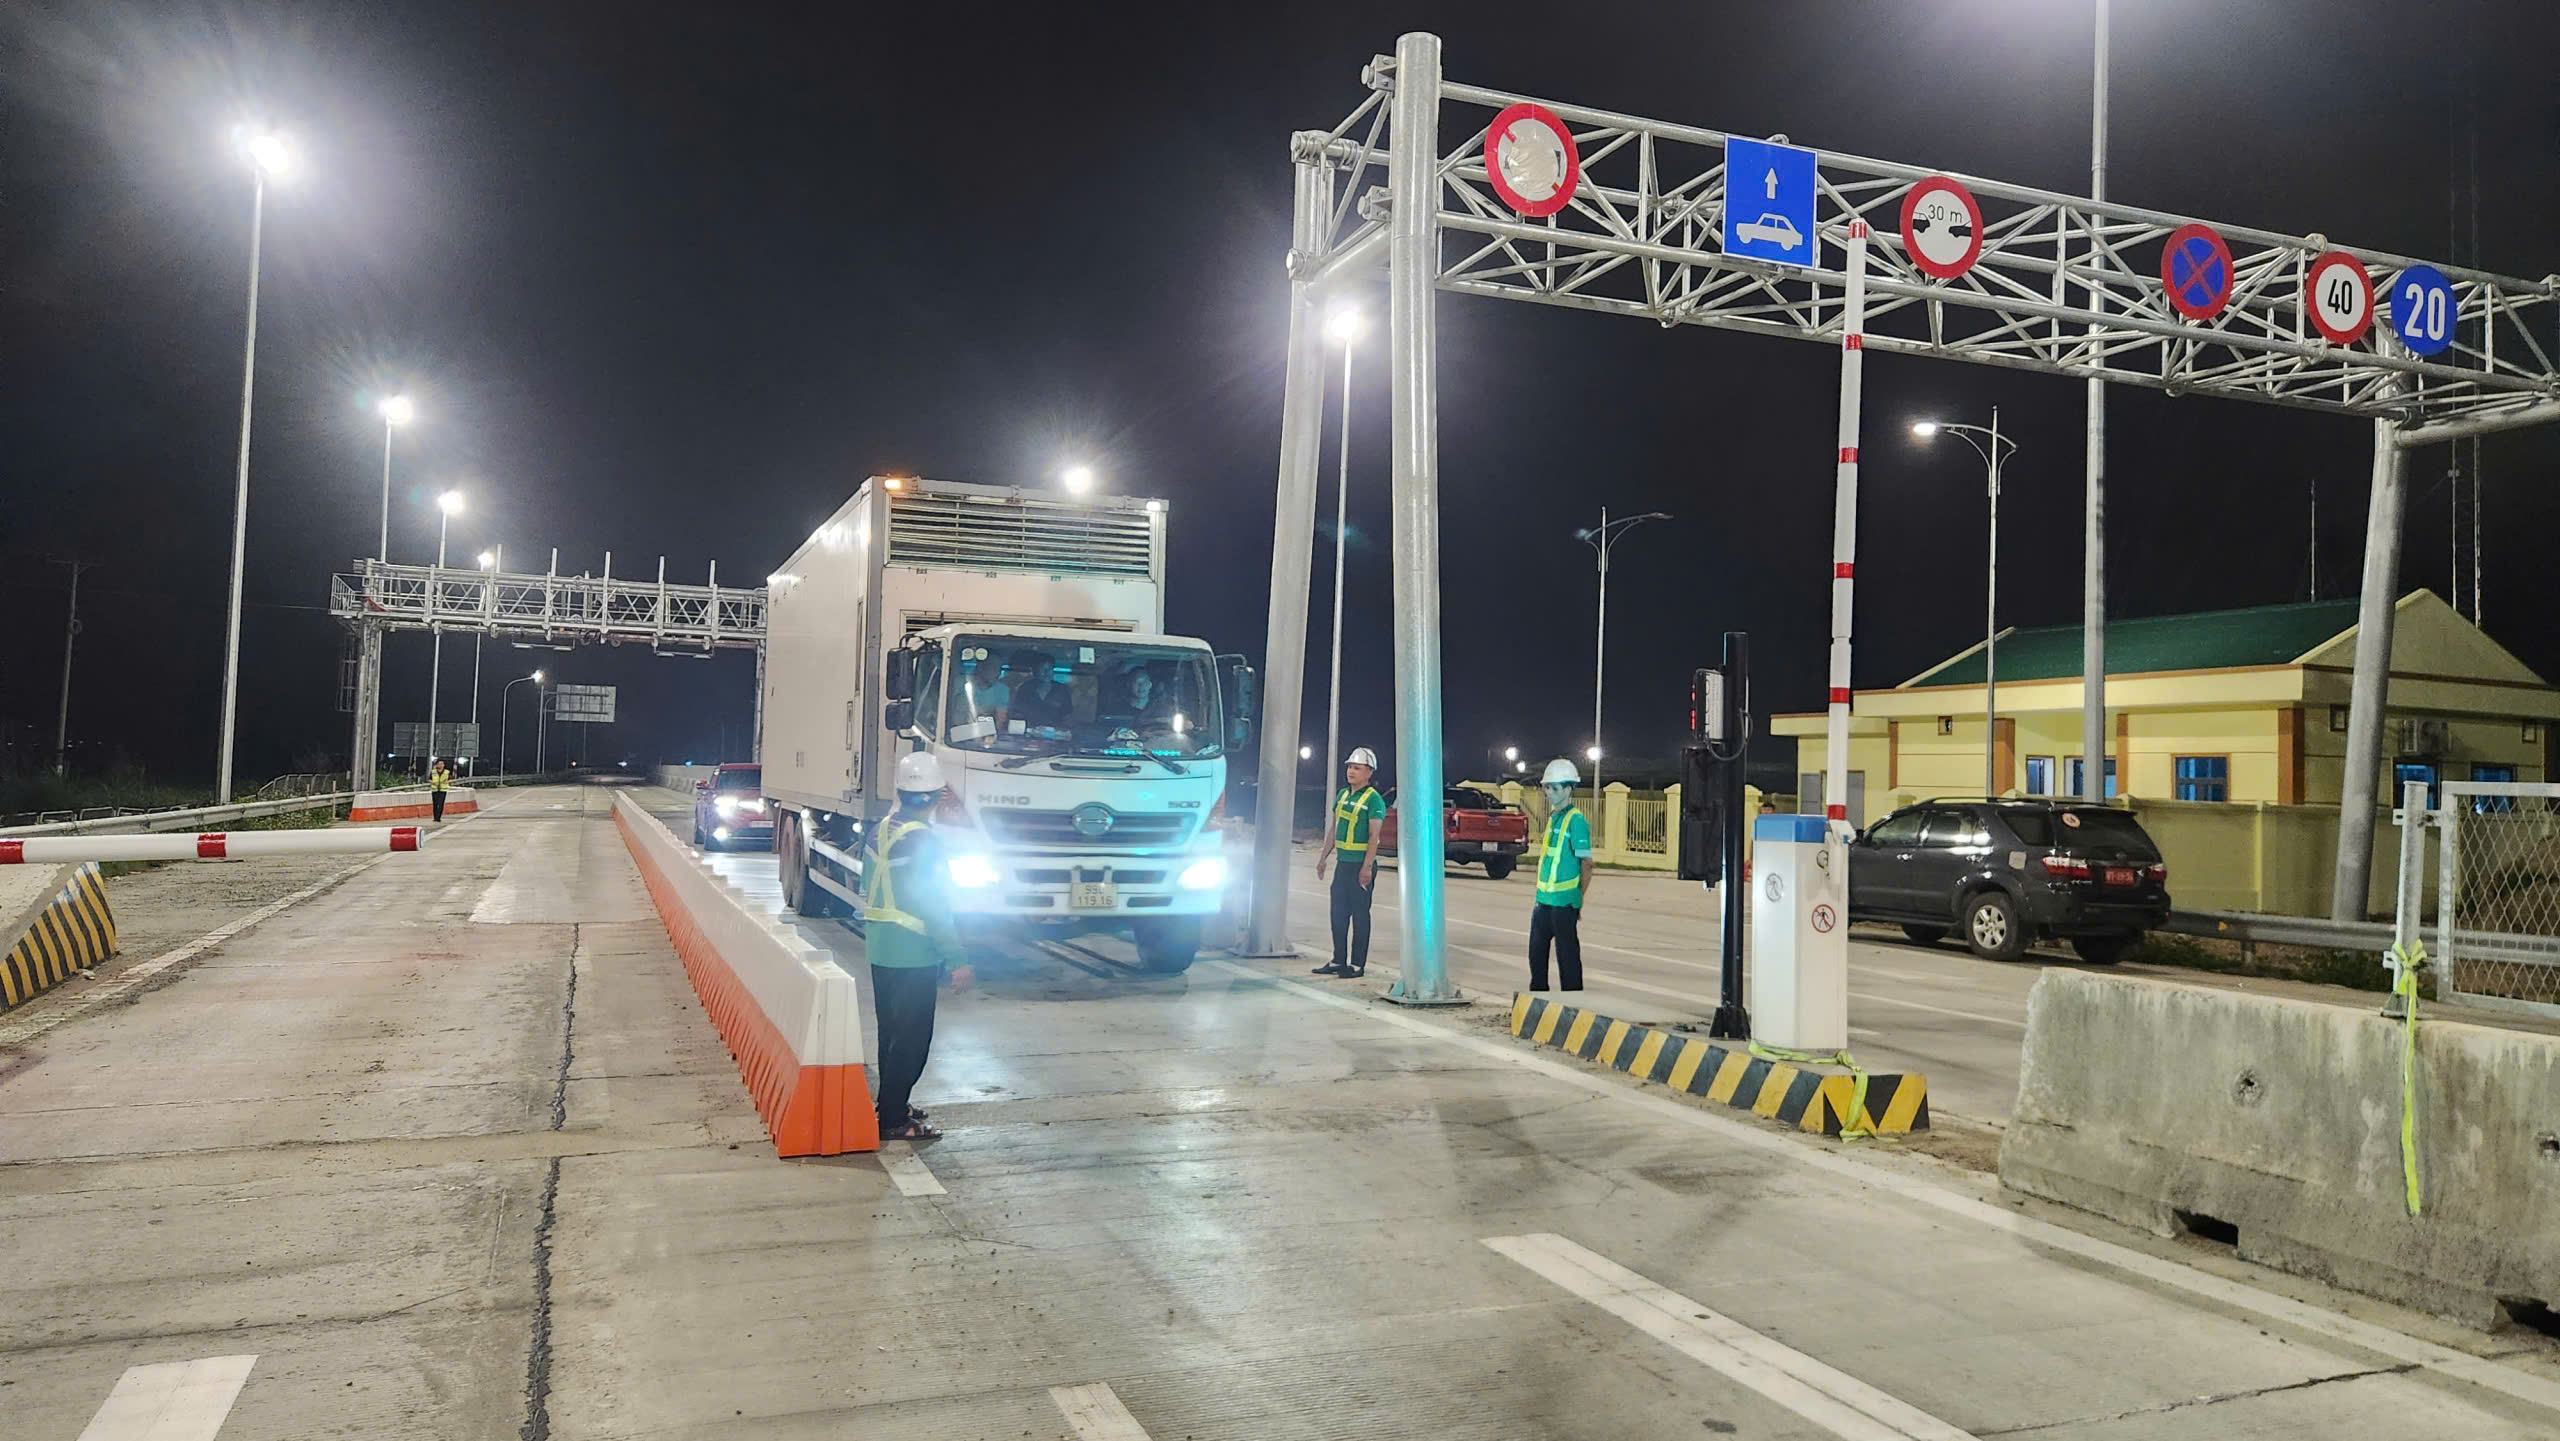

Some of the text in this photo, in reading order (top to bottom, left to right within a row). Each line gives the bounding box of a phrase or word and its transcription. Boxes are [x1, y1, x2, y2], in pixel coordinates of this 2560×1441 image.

[1928, 204, 1962, 223] 30 m
[2327, 279, 2353, 315] 40
[2404, 283, 2446, 341] 20
[978, 794, 1031, 806] HINO
